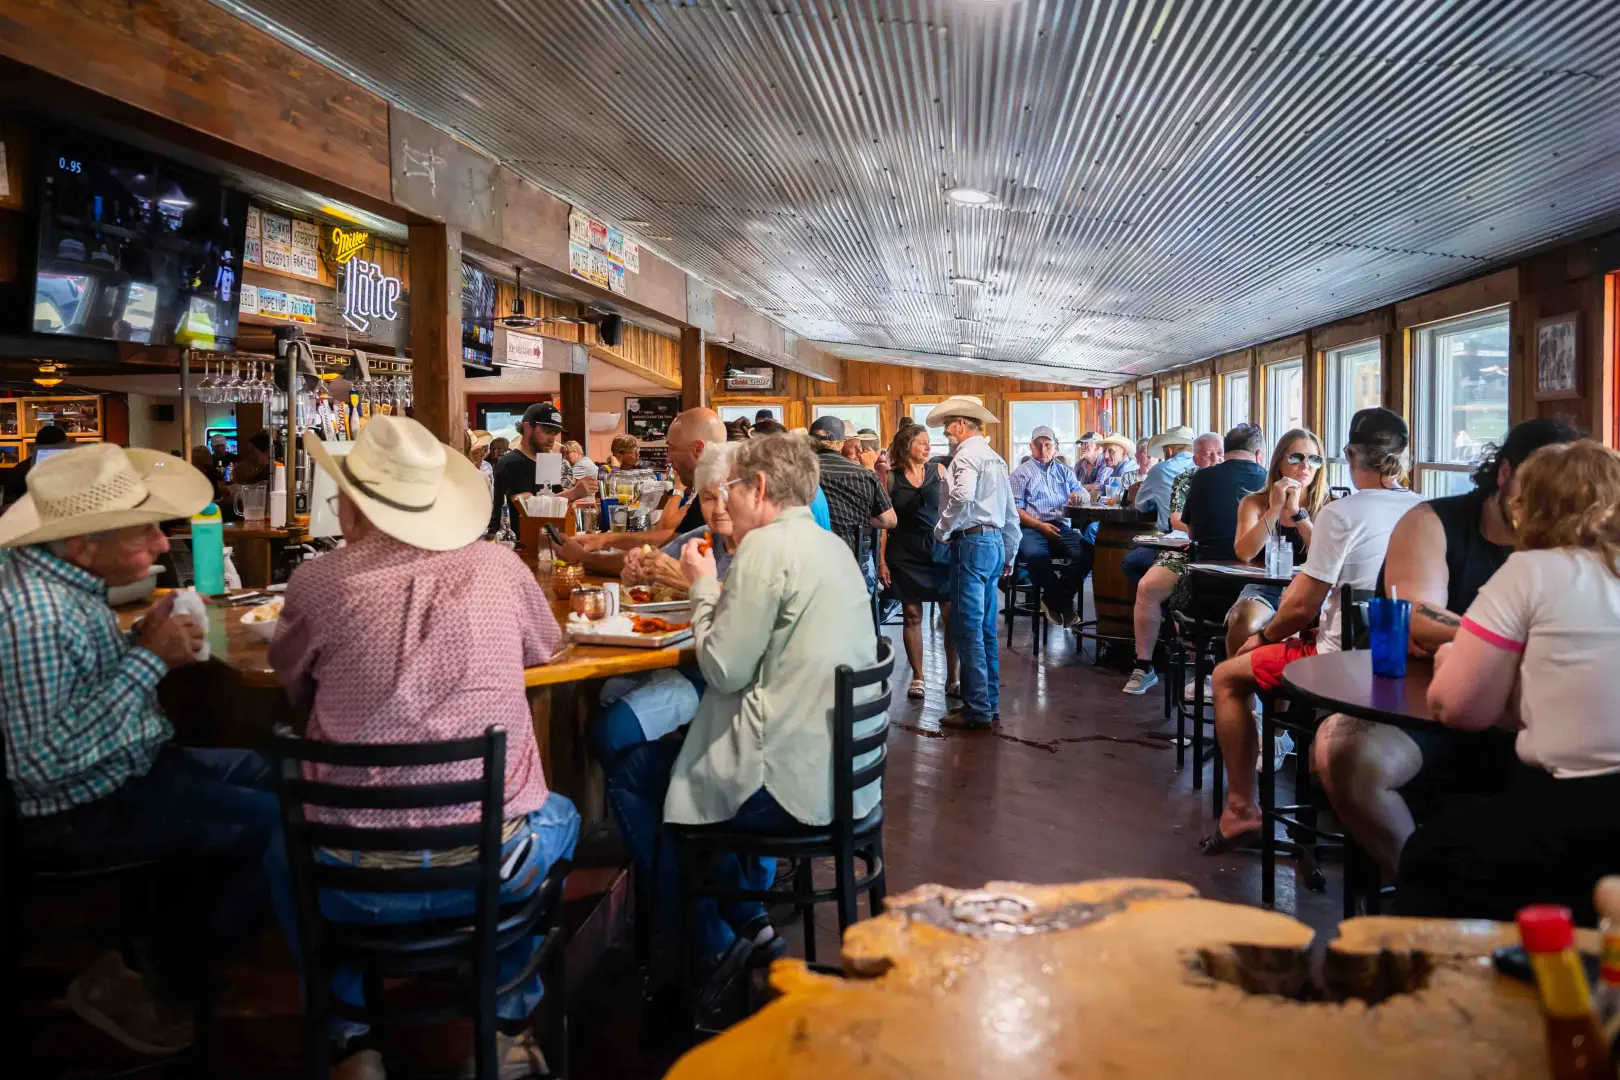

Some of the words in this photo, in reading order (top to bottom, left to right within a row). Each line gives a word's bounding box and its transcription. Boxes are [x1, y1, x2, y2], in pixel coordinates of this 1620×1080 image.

[59, 157, 82, 174] 0.95
[333, 228, 368, 258] Miller
[342, 256, 400, 332] Lite
